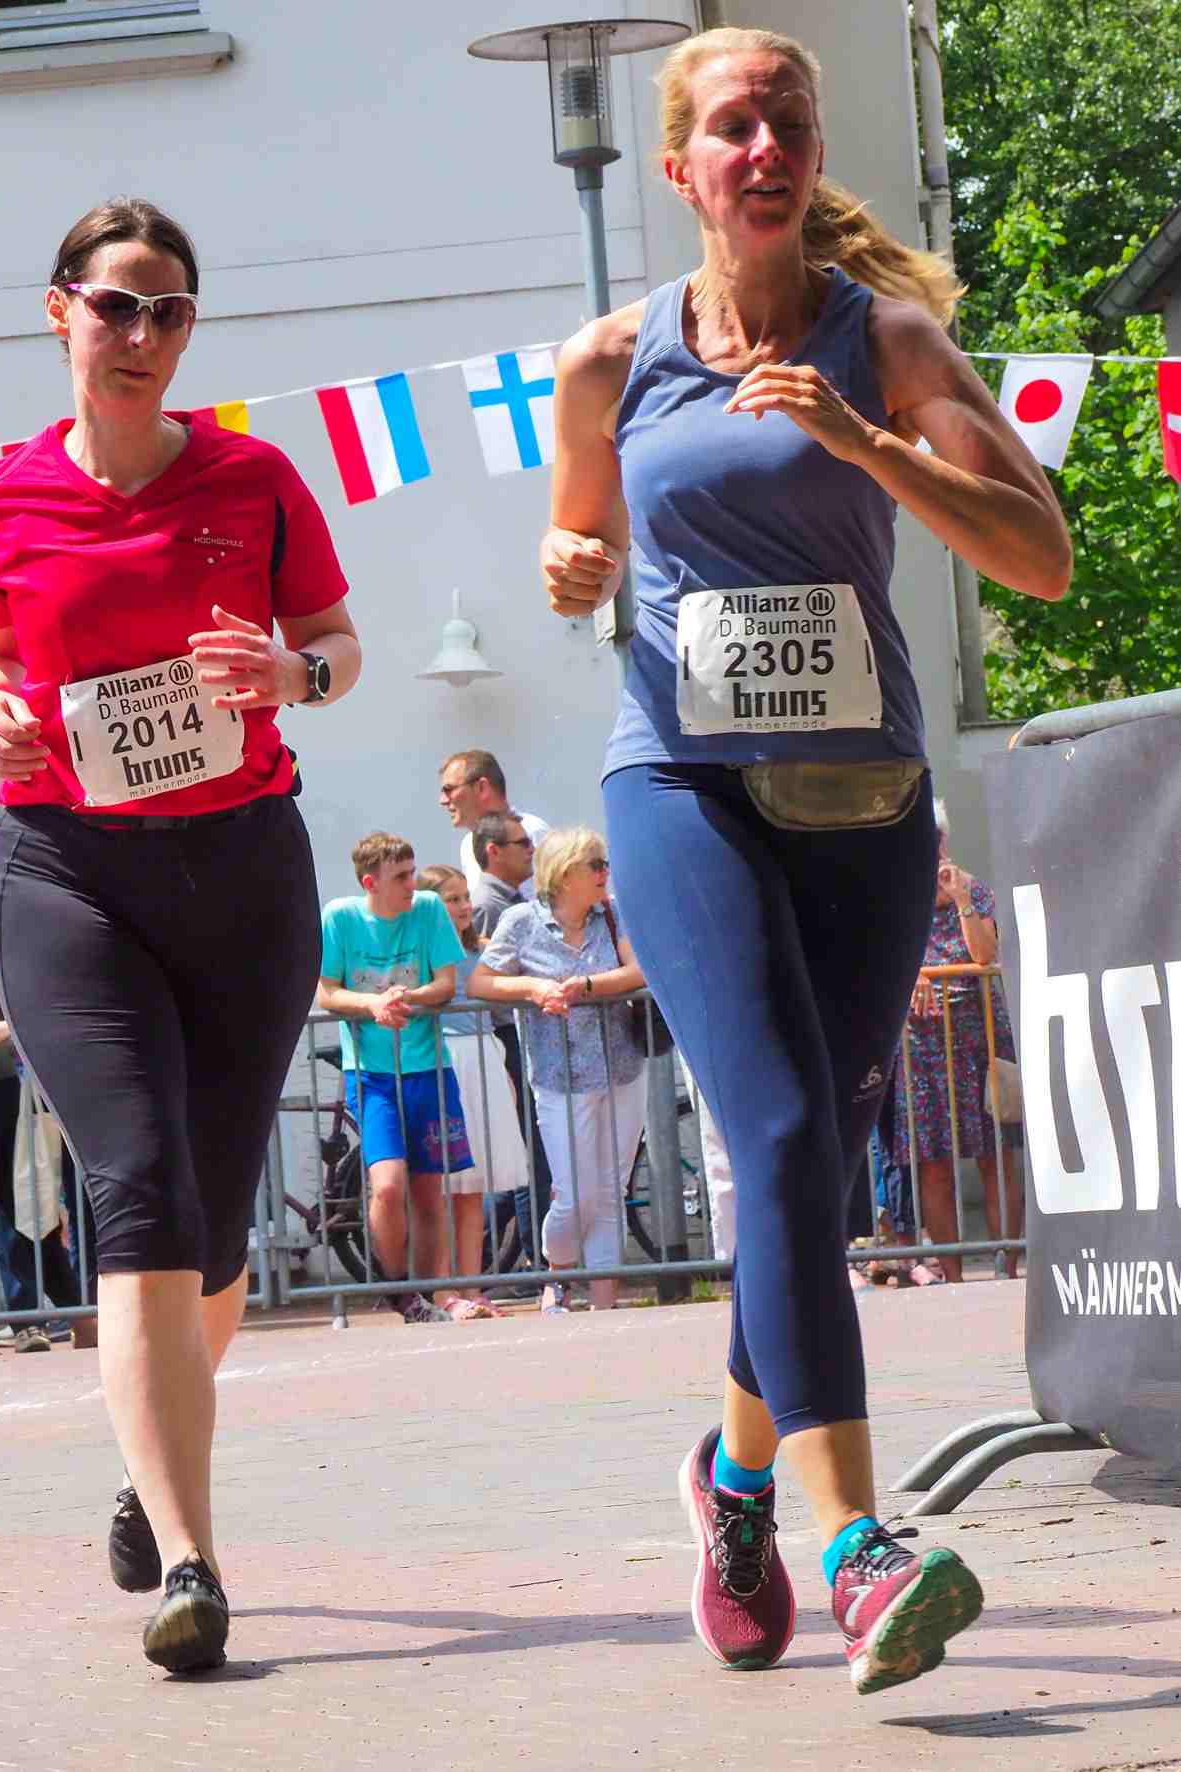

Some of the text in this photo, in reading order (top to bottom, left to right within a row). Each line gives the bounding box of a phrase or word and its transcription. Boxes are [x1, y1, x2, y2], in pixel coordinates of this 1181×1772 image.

[719, 594, 800, 615] Allianz
[720, 617, 836, 637] D. Baumann
[723, 639, 835, 678] 2305
[96, 672, 166, 701] Allianz
[98, 684, 199, 720] D. Baumann
[733, 682, 827, 719] bruns
[107, 703, 204, 754] 2014
[121, 747, 206, 788] bruns
[1013, 883, 1181, 1214] br
